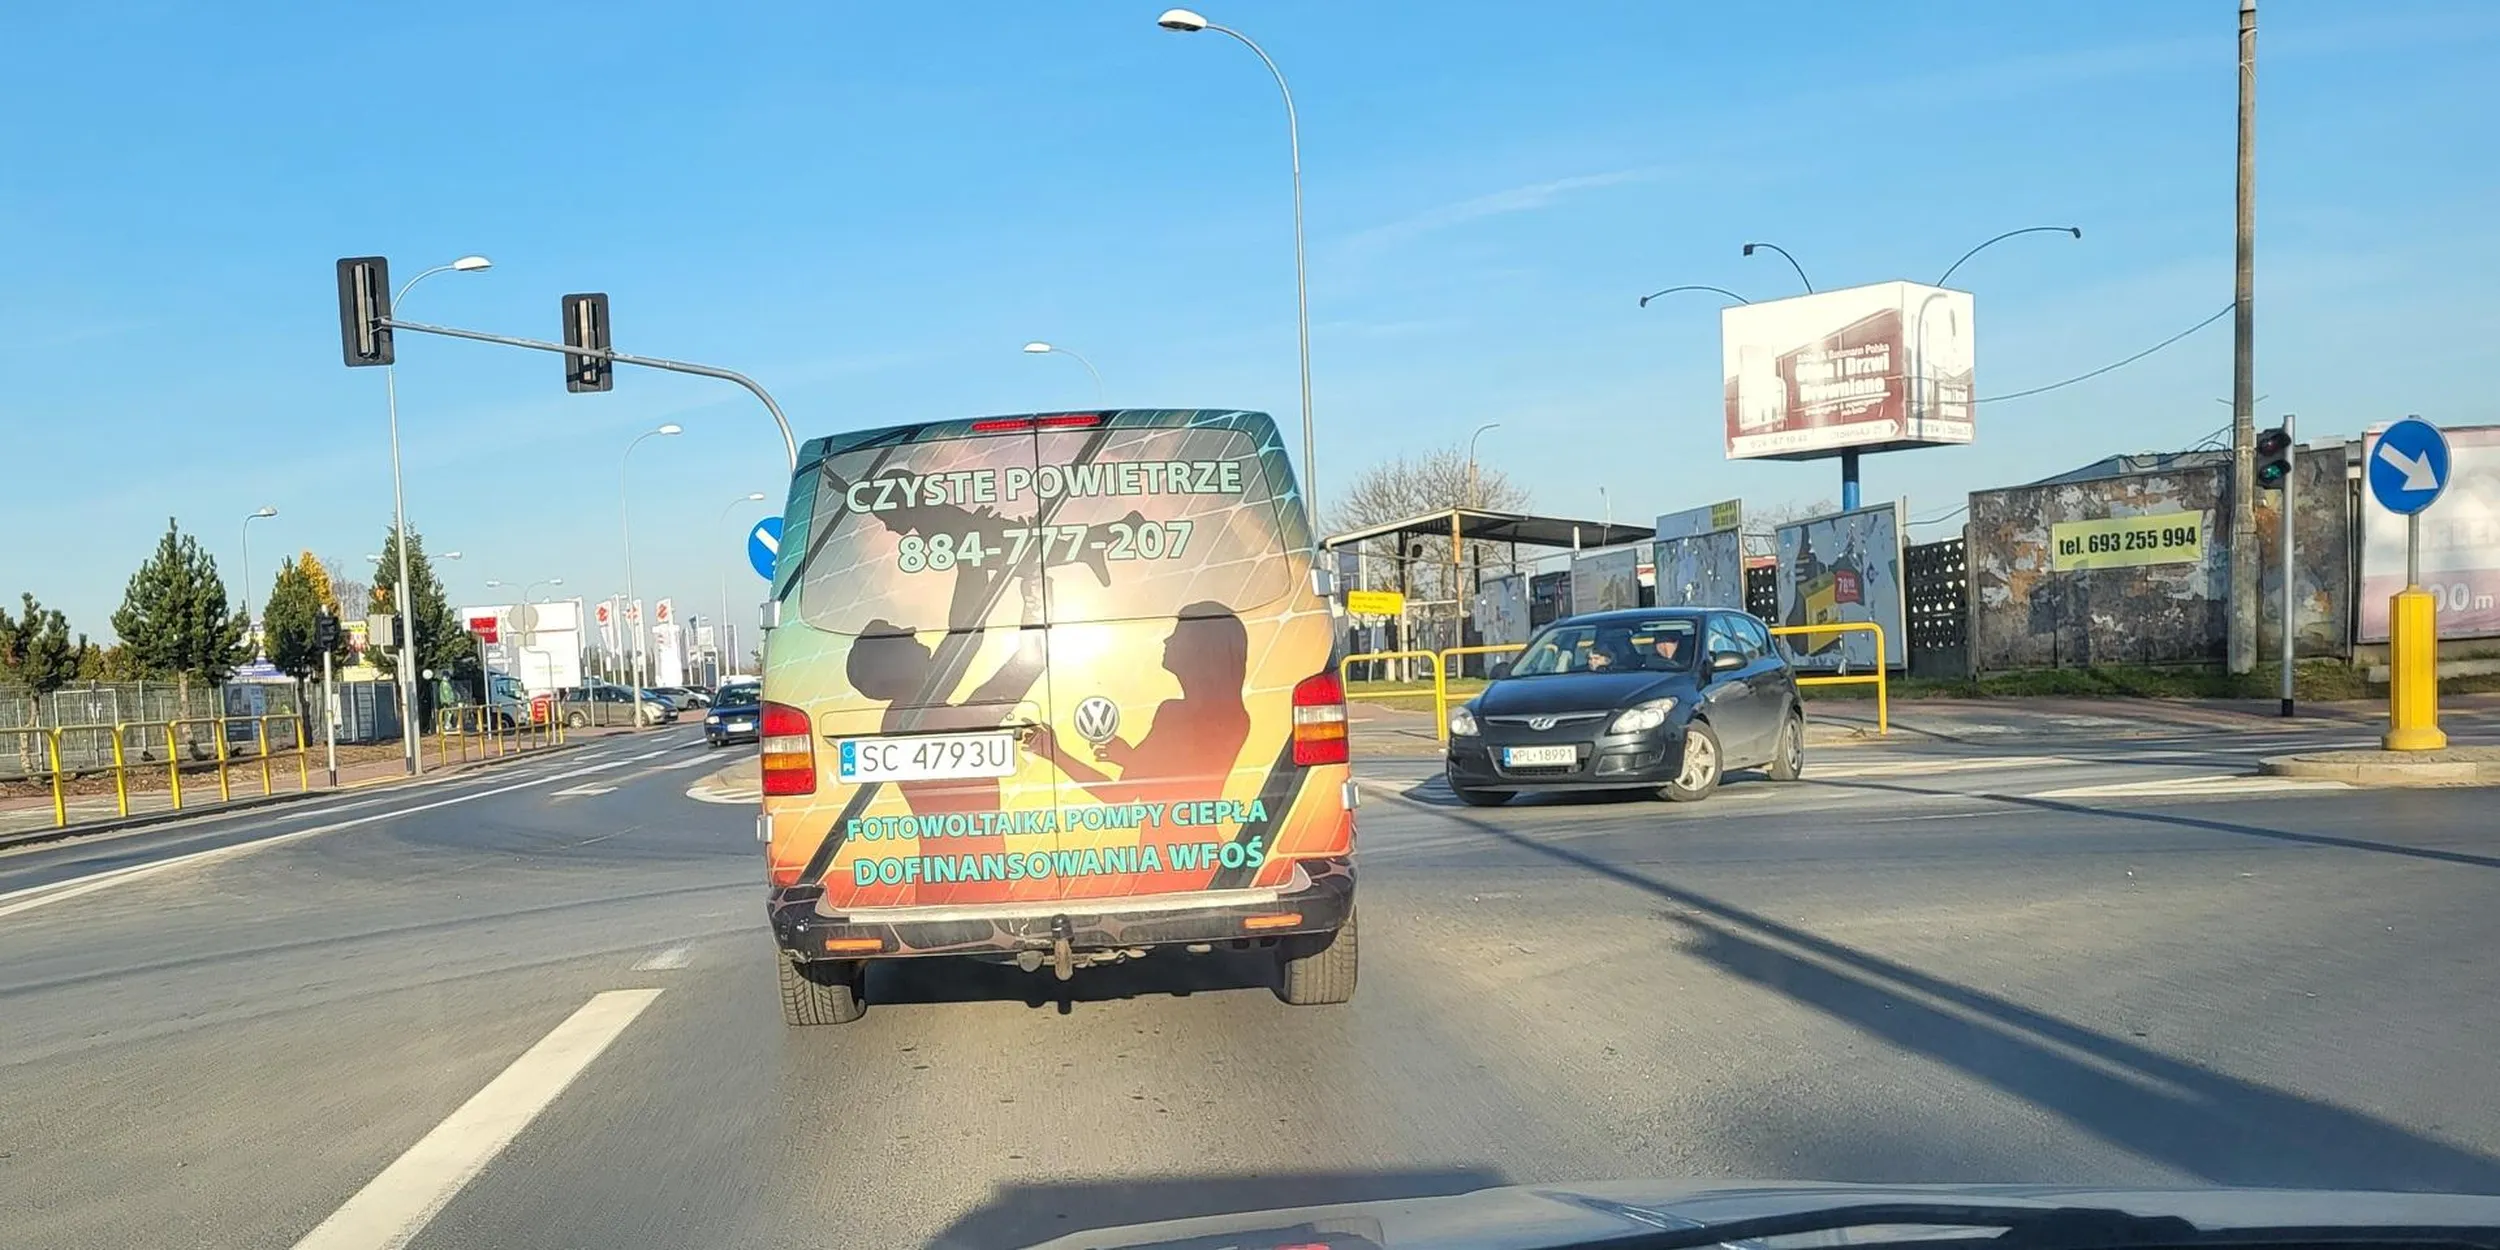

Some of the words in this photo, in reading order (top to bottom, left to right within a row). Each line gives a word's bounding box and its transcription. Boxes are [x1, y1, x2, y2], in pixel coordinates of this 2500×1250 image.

[846, 469, 997, 514] CZYSTE
[1005, 460, 1244, 502] POWIETRZE
[898, 520, 1194, 573] 884-777-207
[2059, 537, 2085, 556] tel.
[2088, 533, 2121, 554] 693
[2125, 529, 2158, 551] 255
[2162, 526, 2197, 548] 994
[862, 744, 899, 772] SC
[912, 739, 1006, 770] 4793U
[846, 810, 1059, 842] FOTOWOLTAIKA
[1065, 803, 1165, 832] POMPY
[1170, 798, 1268, 826] CIEPŁA
[853, 844, 1164, 887] DOFINANSOWANIA
[1167, 835, 1265, 873] WFOŚ
